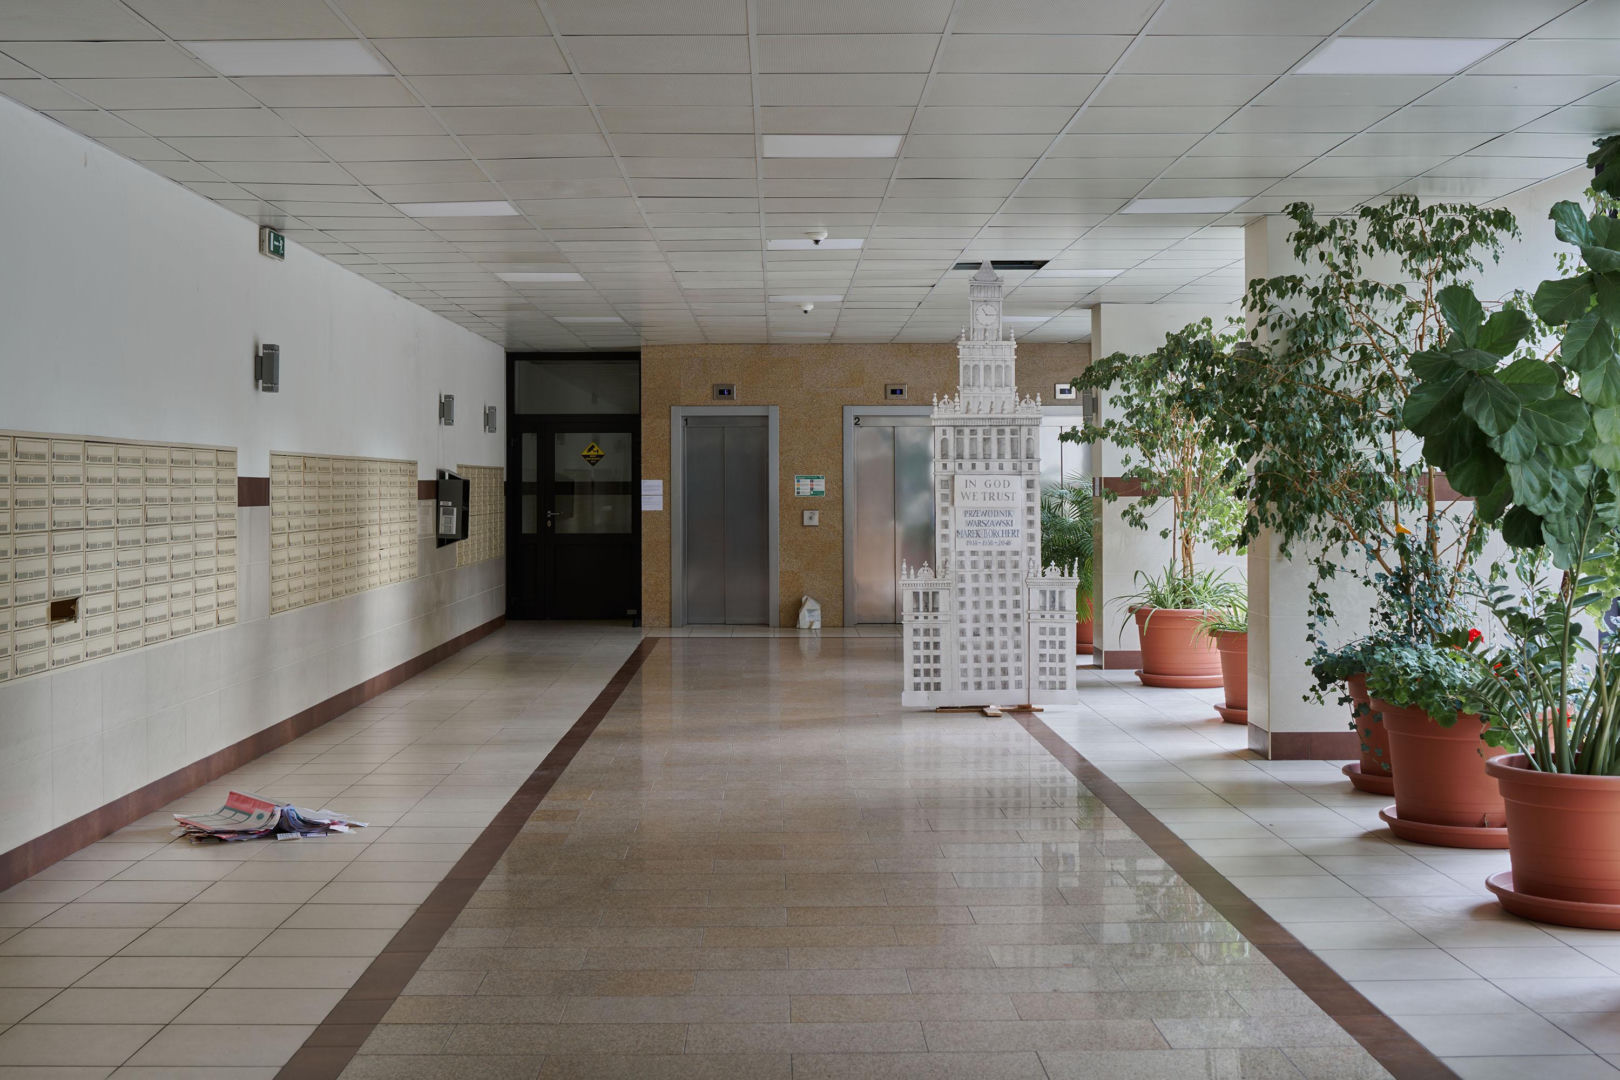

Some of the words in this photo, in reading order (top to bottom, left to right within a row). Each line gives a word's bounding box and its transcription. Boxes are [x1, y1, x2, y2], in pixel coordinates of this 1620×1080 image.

[854, 417, 861, 426] 2
[965, 479, 977, 489] IN
[984, 479, 1011, 489] GOD
[960, 491, 977, 501] WE
[981, 491, 1016, 501] TRUST
[964, 510, 1013, 518] PRZEWODNIK
[967, 519, 1014, 527] WARSZAWSKI
[956, 530, 981, 538] MAREK
